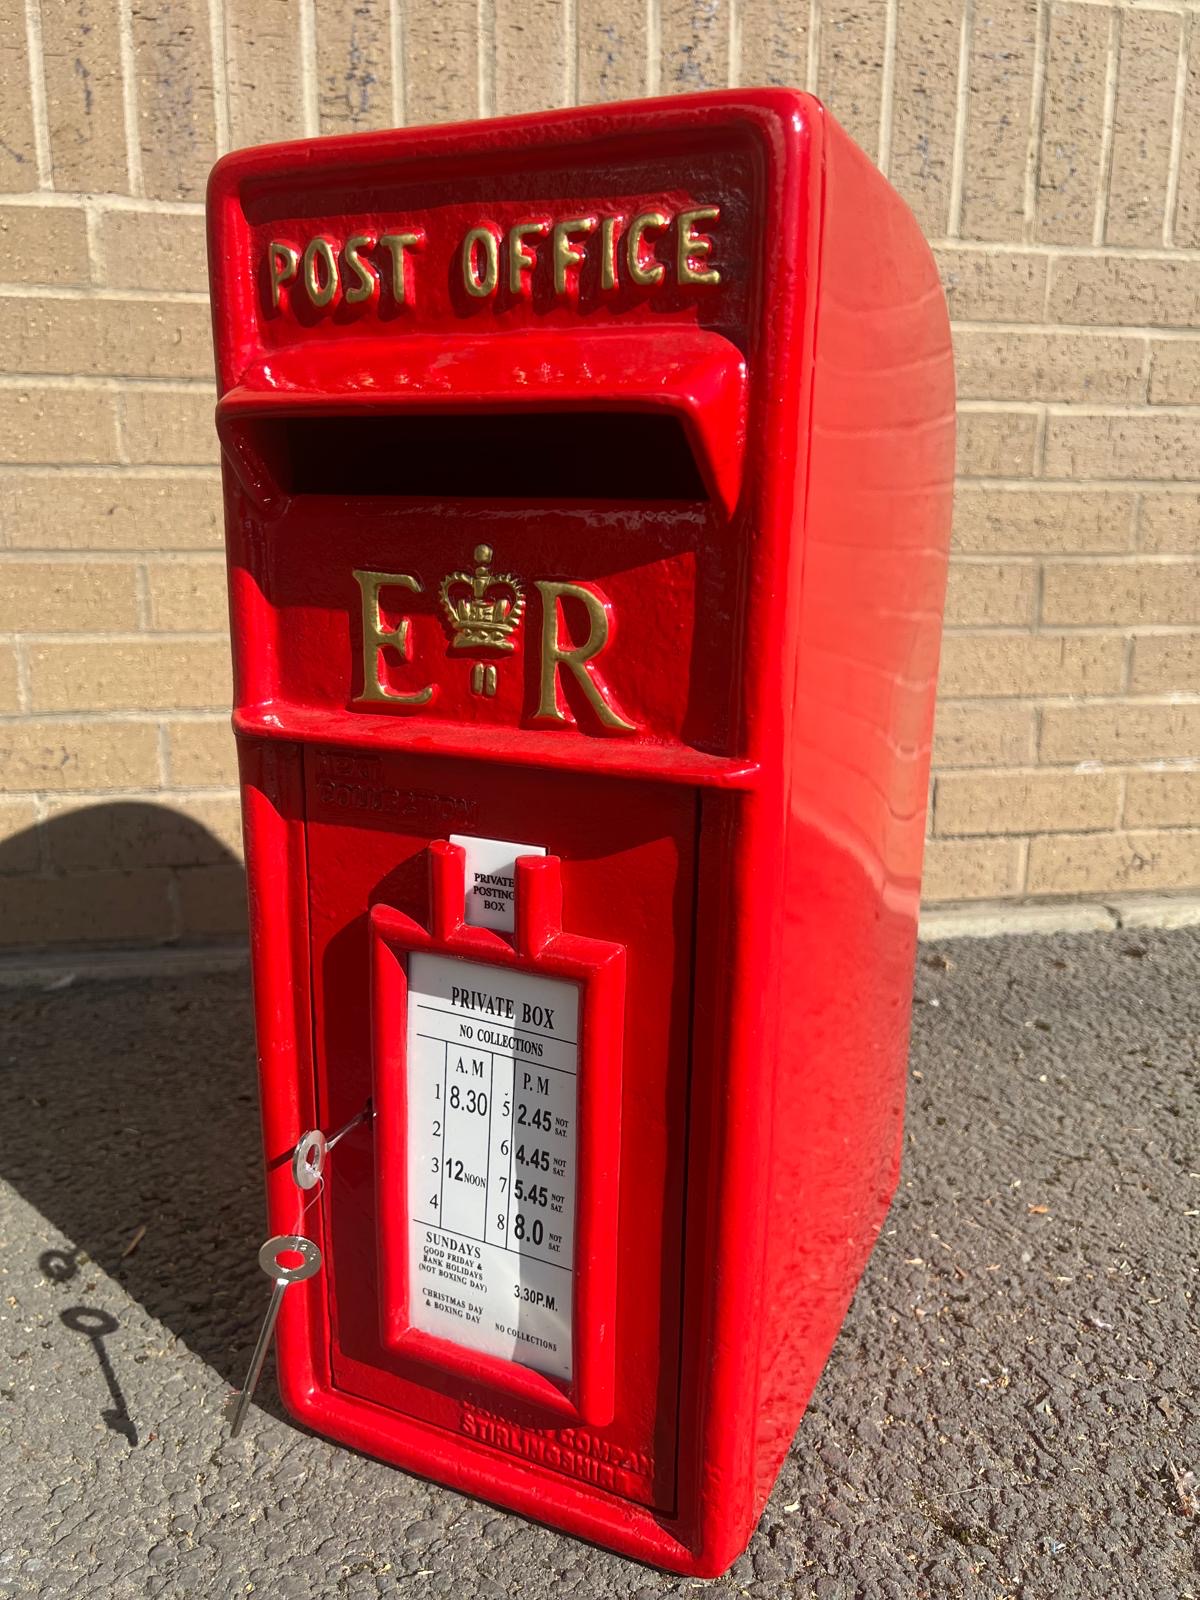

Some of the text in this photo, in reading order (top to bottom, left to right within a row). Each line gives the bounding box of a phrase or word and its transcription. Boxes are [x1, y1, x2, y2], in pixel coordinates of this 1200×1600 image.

[268, 207, 722, 308] POST OFFICE
[352, 568, 637, 731] E R
[472, 886, 515, 901] POSTING
[474, 873, 515, 888] PRIVATE
[484, 899, 506, 912] BOX
[451, 986, 555, 1030] PRIVATE BOX
[459, 1024, 544, 1057] NO COLLECTIONS
[435, 1083, 487, 1117] 1 8.30
[432, 1120, 441, 1137] 2
[502, 1101, 569, 1132] 5 2.45 NOT
[431, 1156, 439, 1173] 3
[500, 1139, 567, 1172] 6 4.45 NOT
[429, 1193, 438, 1209] 4
[499, 1176, 565, 1208] 7 5.45 NOT
[497, 1213, 563, 1246] 8 8.0 NOT
[423, 1245, 483, 1271] GOOD FRIDAY &
[426, 1231, 481, 1259] SUNDAYS
[418, 1262, 488, 1294] (NOT BOXING DAY)
[423, 1254, 483, 1281] BANK HOLIDAYS
[422, 1286, 484, 1316] CHRISTMAS DAY
[425, 1298, 481, 1325] & BOXING DAY
[495, 1322, 558, 1353] NO COLLECTIONS
